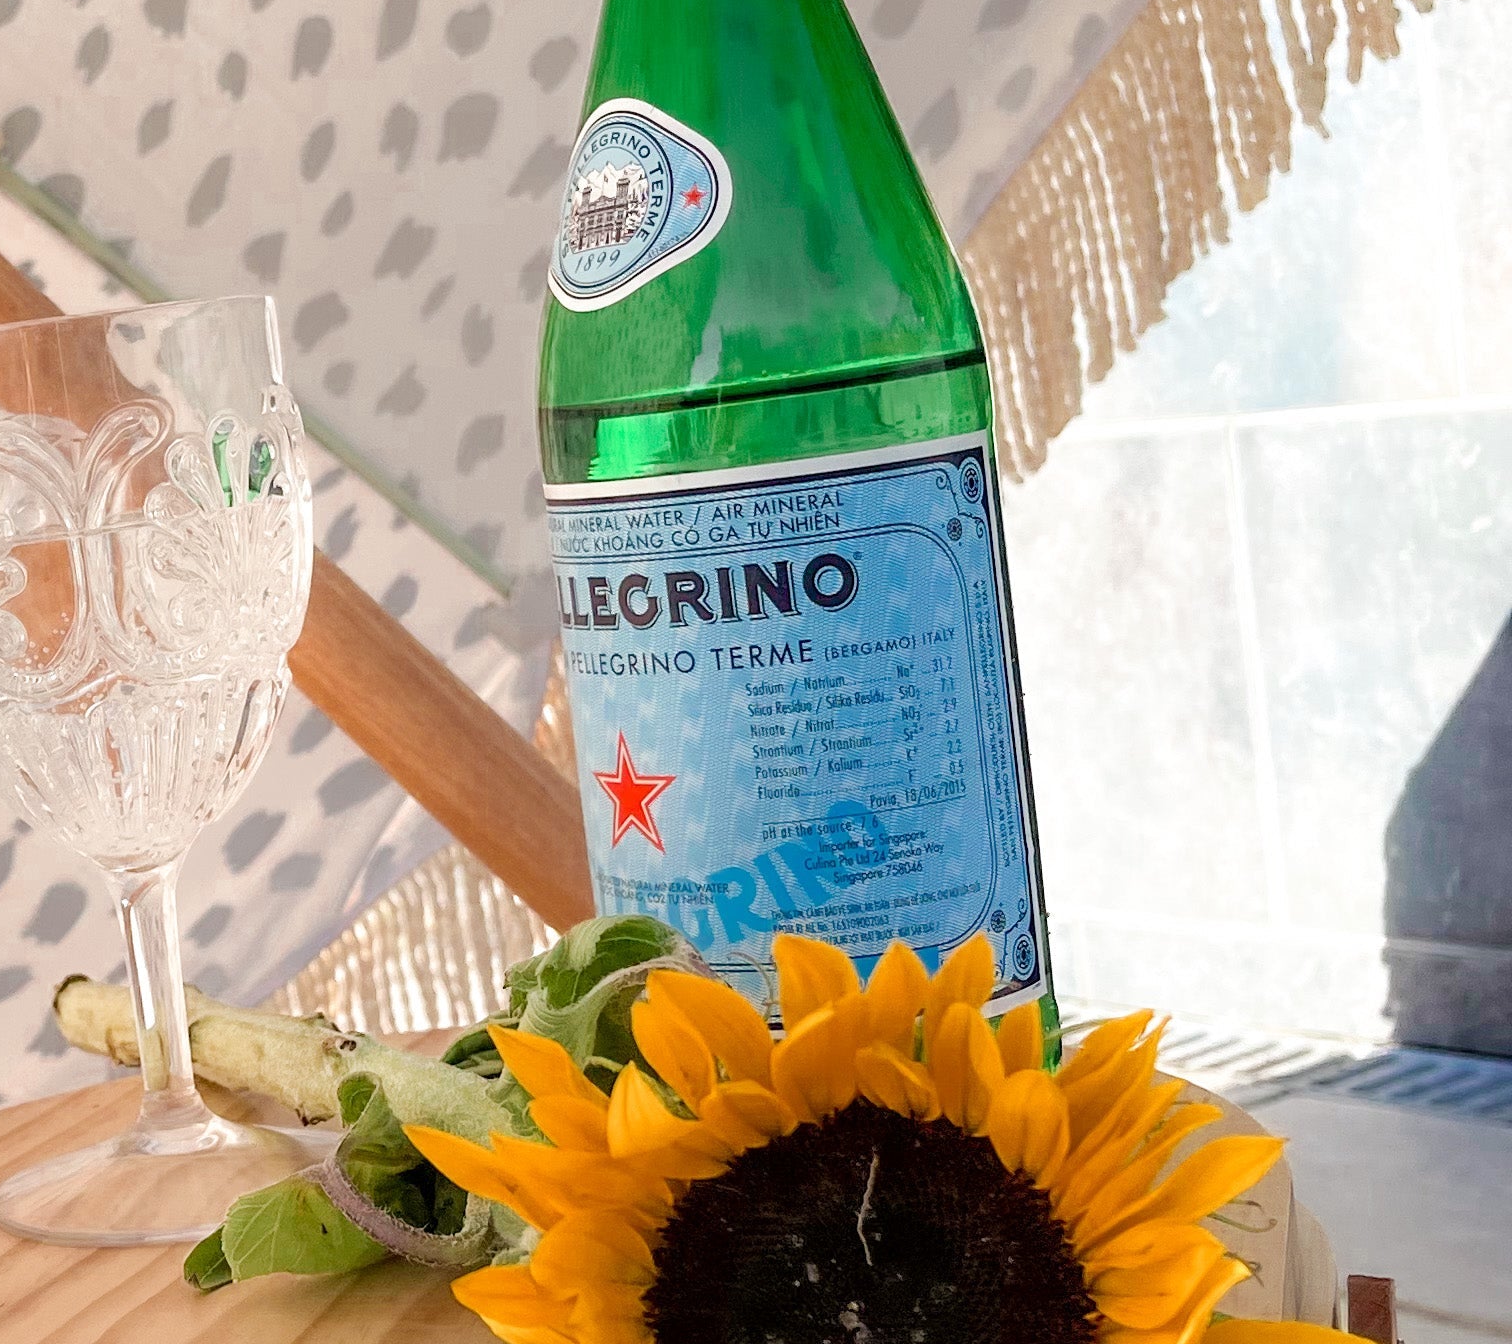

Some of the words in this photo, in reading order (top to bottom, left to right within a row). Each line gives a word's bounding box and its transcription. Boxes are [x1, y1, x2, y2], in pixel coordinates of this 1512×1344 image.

[636, 160, 665, 243] TERME
[575, 249, 621, 274] 1899
[568, 515, 621, 533] MINERAL
[625, 510, 685, 528] WATER
[694, 506, 701, 525] /
[712, 504, 745, 522] AIR
[753, 491, 844, 516] MINERAL
[672, 526, 700, 546] CÓ
[709, 526, 740, 543] GA
[780, 510, 840, 535] NHIÊN
[570, 649, 696, 676] PELLEGRINO
[710, 639, 814, 672] TERME
[825, 634, 916, 662] (BERGAMO)
[922, 627, 955, 646] ITALY
[745, 679, 784, 697] Sodium
[750, 724, 786, 737] Nitrate
[805, 719, 835, 733] Nitrat
[752, 743, 804, 759] Strontium
[821, 736, 872, 753] Strontium
[755, 765, 808, 779] Potassium
[828, 757, 863, 773] Kalium
[762, 825, 777, 842] pH
[780, 827, 792, 839] at
[795, 823, 813, 837] the
[819, 838, 859, 854] Importer
[862, 833, 876, 848] for
[804, 855, 836, 871] Culina
[838, 854, 854, 867] Pte
[856, 850, 870, 865] Ltd
[872, 850, 886, 863] 24
[888, 843, 922, 861] Senoko
[924, 841, 945, 855] Way
[833, 870, 884, 886] Singapore
[885, 860, 924, 876] 758046
[695, 882, 729, 894] WATER
